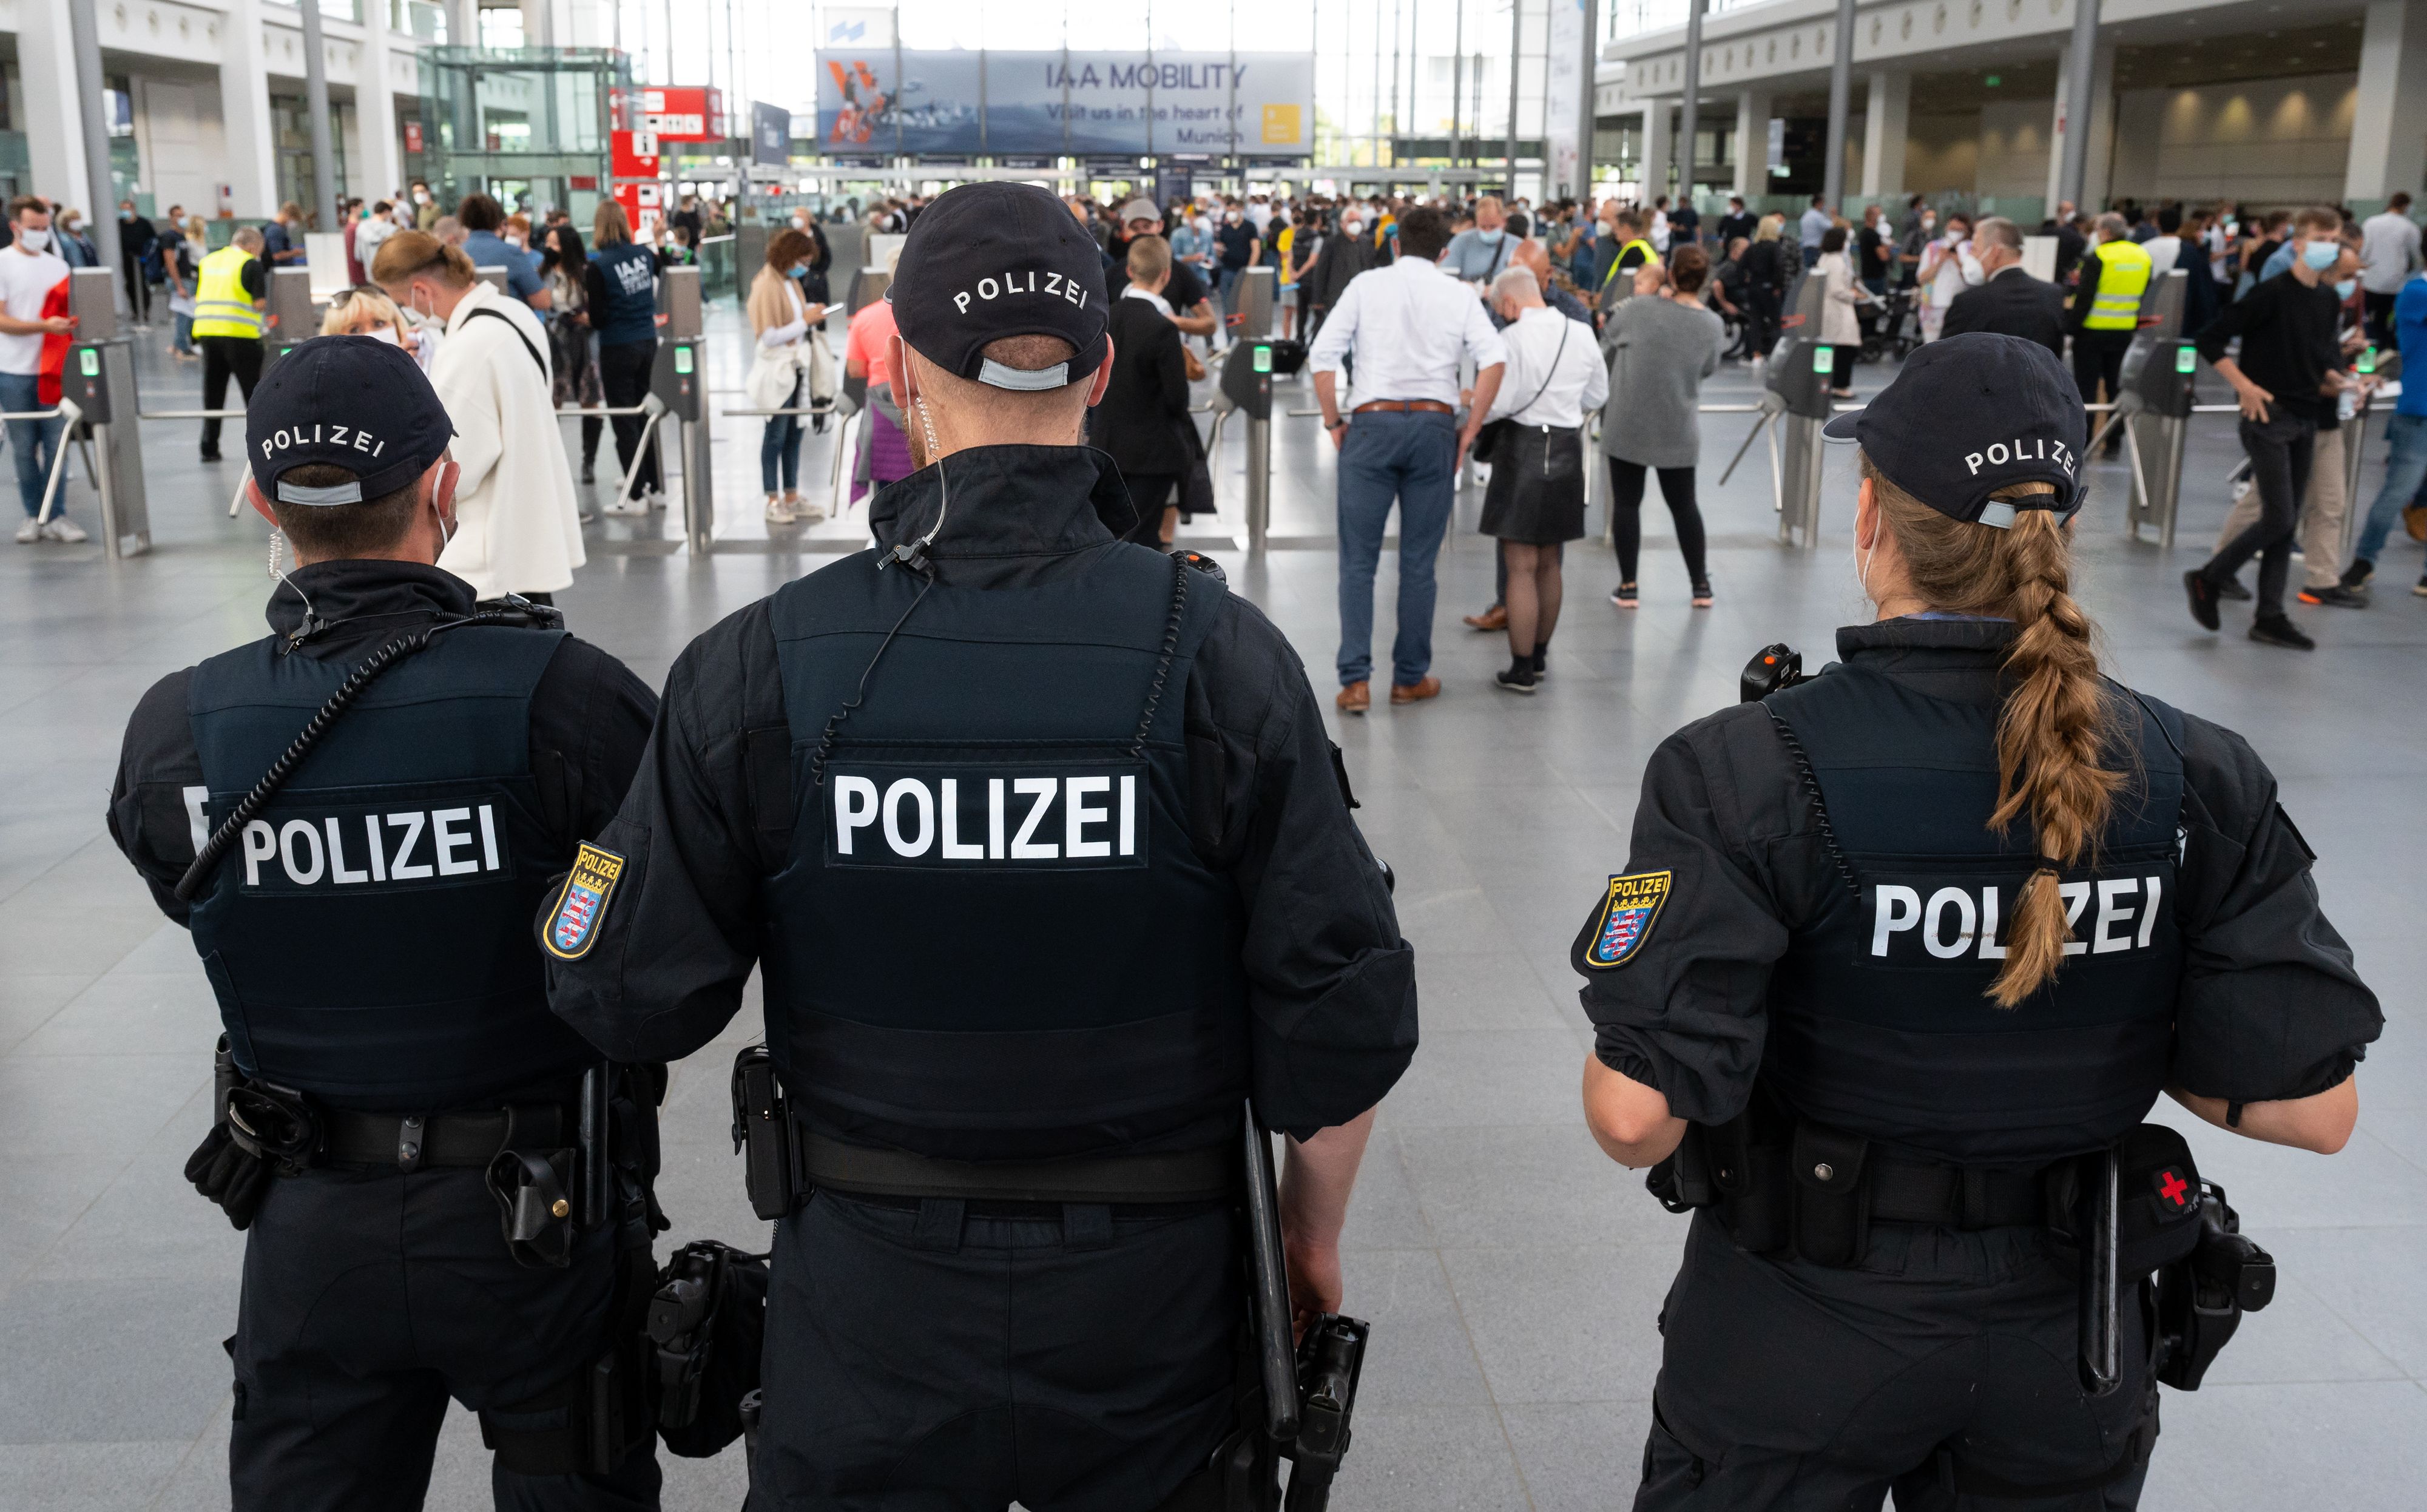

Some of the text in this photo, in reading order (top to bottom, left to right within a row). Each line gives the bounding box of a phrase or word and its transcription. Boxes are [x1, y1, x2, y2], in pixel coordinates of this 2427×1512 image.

[1046, 63, 1247, 89] IAA MOBILITY
[1092, 109, 1111, 120] us
[1117, 103, 1135, 119] in
[1173, 105, 1220, 120] heart
[1226, 104, 1243, 120] of
[1177, 128, 1244, 144] Munich
[953, 271, 1088, 314] POLIZEI
[262, 424, 385, 460] POLIZEI
[835, 775, 1135, 859] POLIZEI
[243, 805, 499, 886] POLIZEI
[579, 851, 620, 880] POLIZEI
[1612, 877, 1667, 898] POLIZEI
[1871, 877, 2161, 959] POLZEI
